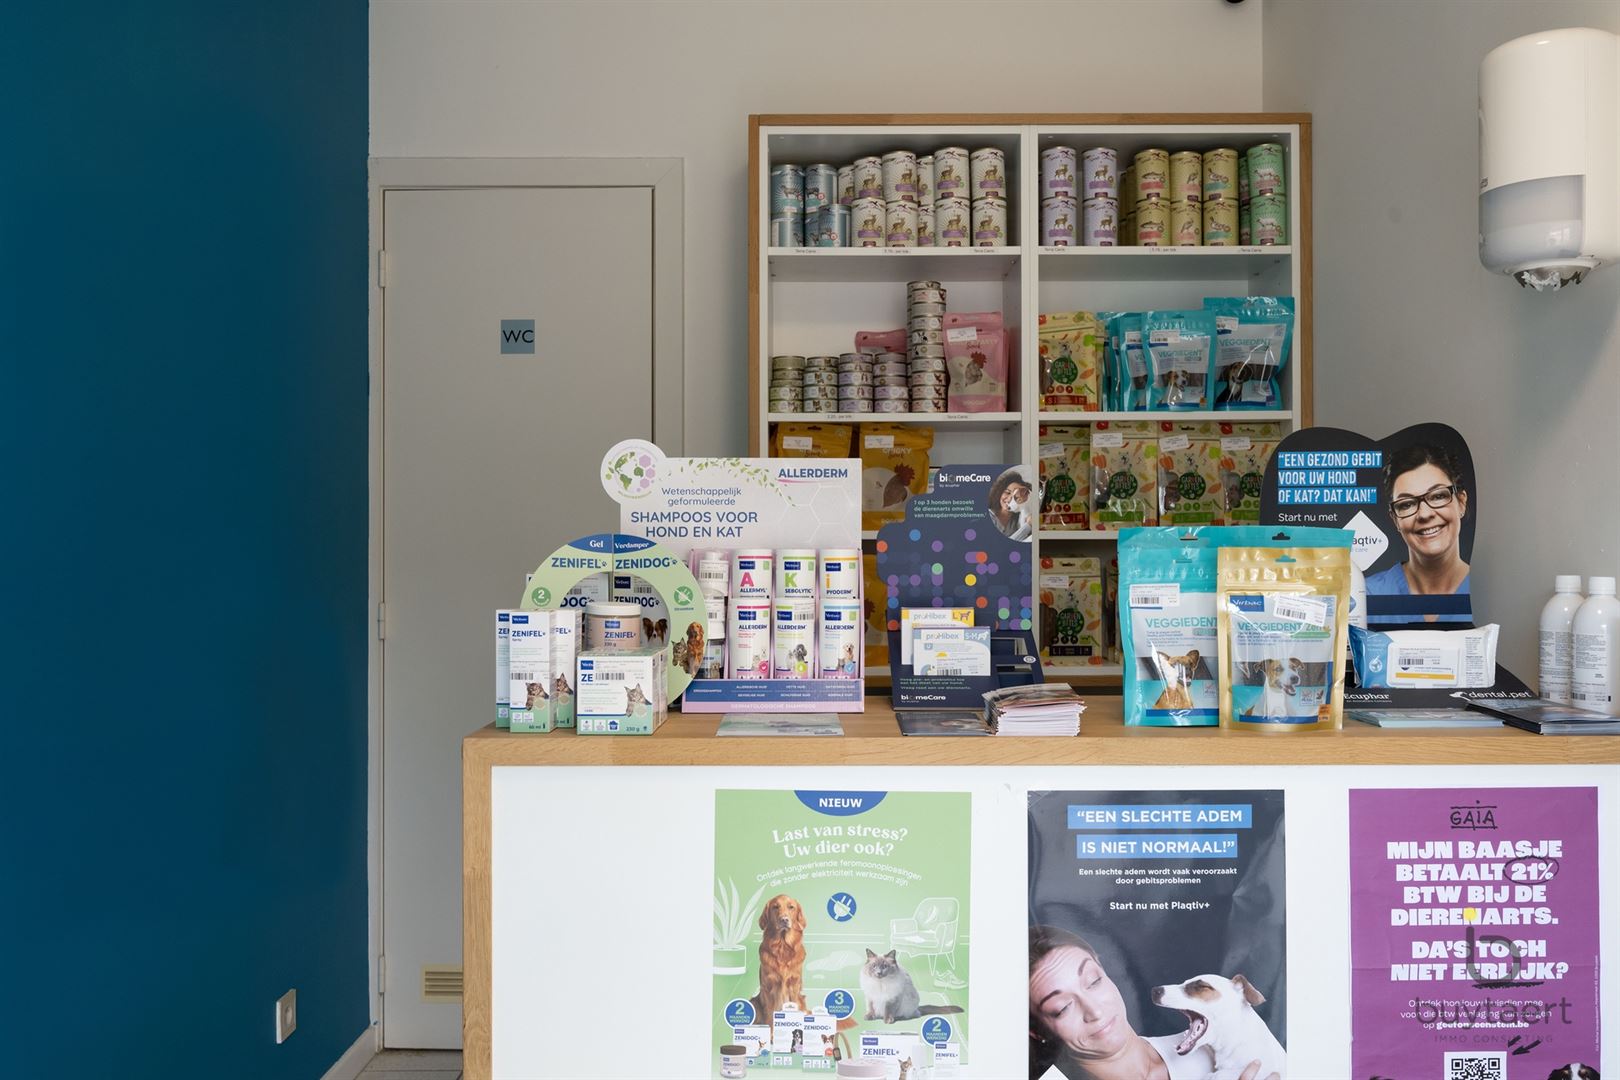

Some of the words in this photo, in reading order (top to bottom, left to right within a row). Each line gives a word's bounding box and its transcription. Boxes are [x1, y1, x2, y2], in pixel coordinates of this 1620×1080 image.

[502, 329, 534, 343] WC
[1220, 338, 1271, 346] VEGGIEDENT
[1307, 453, 1349, 466] GEZOND
[1352, 453, 1382, 466] GEBIT
[778, 468, 848, 478] ALLERDERM
[1278, 471, 1306, 485] VOOR
[1309, 471, 1325, 485] UW
[1328, 471, 1357, 485] HOND
[661, 486, 742, 497] Wetenschappelijk
[1278, 489, 1291, 503] OF
[1294, 489, 1320, 503] KAT?
[1323, 489, 1343, 503] DAT
[668, 496, 736, 507] geformuleerde
[630, 511, 712, 523] SHAMPOOS
[716, 511, 758, 523] VOOR
[1278, 513, 1301, 522] Start
[1303, 513, 1316, 522] nu
[1318, 513, 1338, 522] met
[645, 526, 688, 538] HOND
[693, 526, 712, 538] EN
[716, 526, 744, 538] KAT
[589, 540, 604, 548] Gel
[1352, 536, 1382, 547] aqtiv+
[551, 557, 601, 569] ZENIFEL
[615, 557, 670, 570] ZENIDOG
[740, 572, 754, 587] A
[784, 572, 798, 588] K
[538, 590, 545, 599] 2
[1233, 599, 1262, 607] Virbac
[1237, 622, 1301, 631] VEGGIEDENT
[604, 631, 634, 639] ZENIFEL
[1468, 691, 1532, 699] dental.pet
[819, 798, 862, 808] NIEUW
[1077, 810, 1116, 823] “EEN
[1121, 810, 1192, 823] SLECHTE
[1196, 810, 1243, 823] ADEM
[772, 827, 809, 844] Last
[813, 824, 843, 837] van
[847, 824, 908, 841] stress?
[784, 845, 811, 859] Uw
[815, 840, 850, 854] dier
[854, 842, 895, 857] ook?
[1082, 841, 1096, 854] IS
[1100, 841, 1137, 854] NIET
[1387, 840, 1453, 859] MIJN
[1458, 840, 1563, 859] BAASJE
[756, 869, 784, 882] Ontdek
[784, 860, 838, 875] langwerkende
[840, 859, 922, 881] feromoonoplossingen
[1078, 867, 1094, 875] Een
[1095, 867, 1123, 875] slechte
[1124, 867, 1146, 875] adem
[1147, 867, 1171, 875] wordt
[1172, 867, 1191, 875] vaak
[1192, 867, 1238, 875] veroorzaakt
[1396, 864, 1505, 882] BETAALT
[1511, 862, 1554, 881] 21%
[770, 878, 782, 887] die
[783, 873, 809, 883] zonder
[811, 869, 854, 878] elektriciteit
[855, 871, 894, 883] werkzaam
[895, 876, 909, 887] zijn
[1136, 876, 1201, 886] gebitsproblemen
[1403, 885, 1462, 904] BTW
[1467, 885, 1509, 904] BIJ
[1514, 885, 1547, 904] DE
[1110, 901, 1133, 911] Start
[1150, 902, 1169, 910] met
[1171, 901, 1211, 912] Plaqtiv+
[1391, 907, 1559, 926] DIERENARTS.
[1476, 940, 1547, 959] TOCH
[1391, 962, 1447, 981] NIET
[1452, 962, 1569, 981] EERLIJK?
[834, 992, 844, 1005] 3
[735, 1002, 745, 1015] 2
[932, 1019, 942, 1032] 2
[862, 1048, 896, 1056] ZENIFEL
